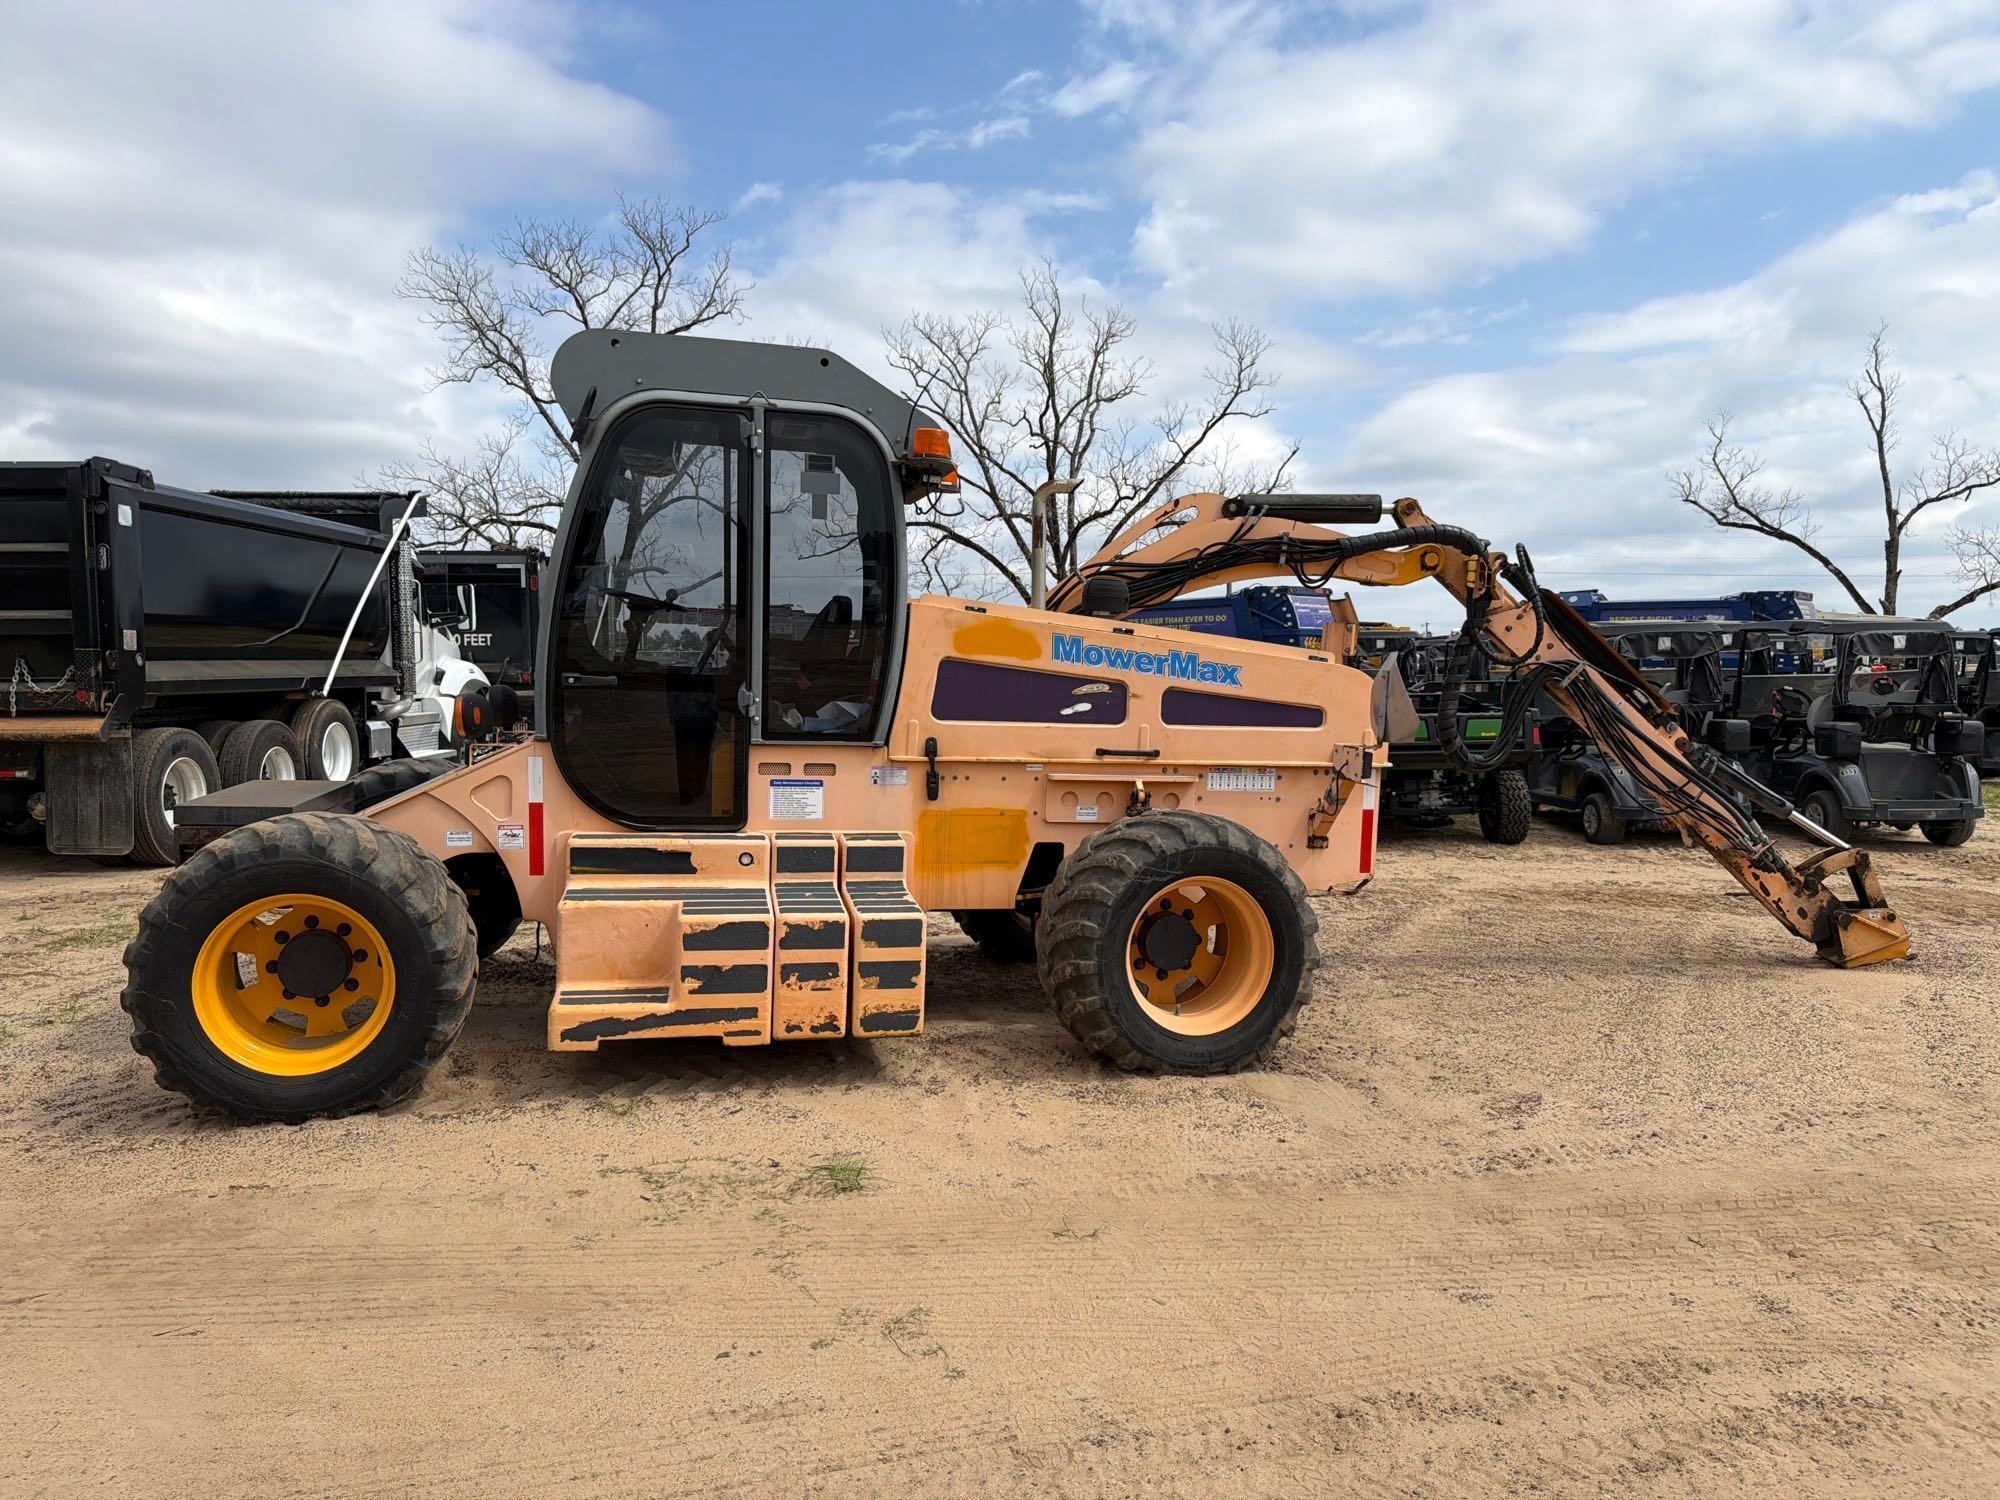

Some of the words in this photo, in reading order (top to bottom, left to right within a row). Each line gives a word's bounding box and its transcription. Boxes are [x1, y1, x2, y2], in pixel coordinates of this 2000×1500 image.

[1140, 617, 1163, 625] EASIER
[1165, 616, 1184, 624] THAN
[1185, 615, 1203, 623] EVER
[1215, 614, 1227, 622] DO
[463, 633, 493, 646] FEET
[1052, 632, 1242, 687] MowerMax
